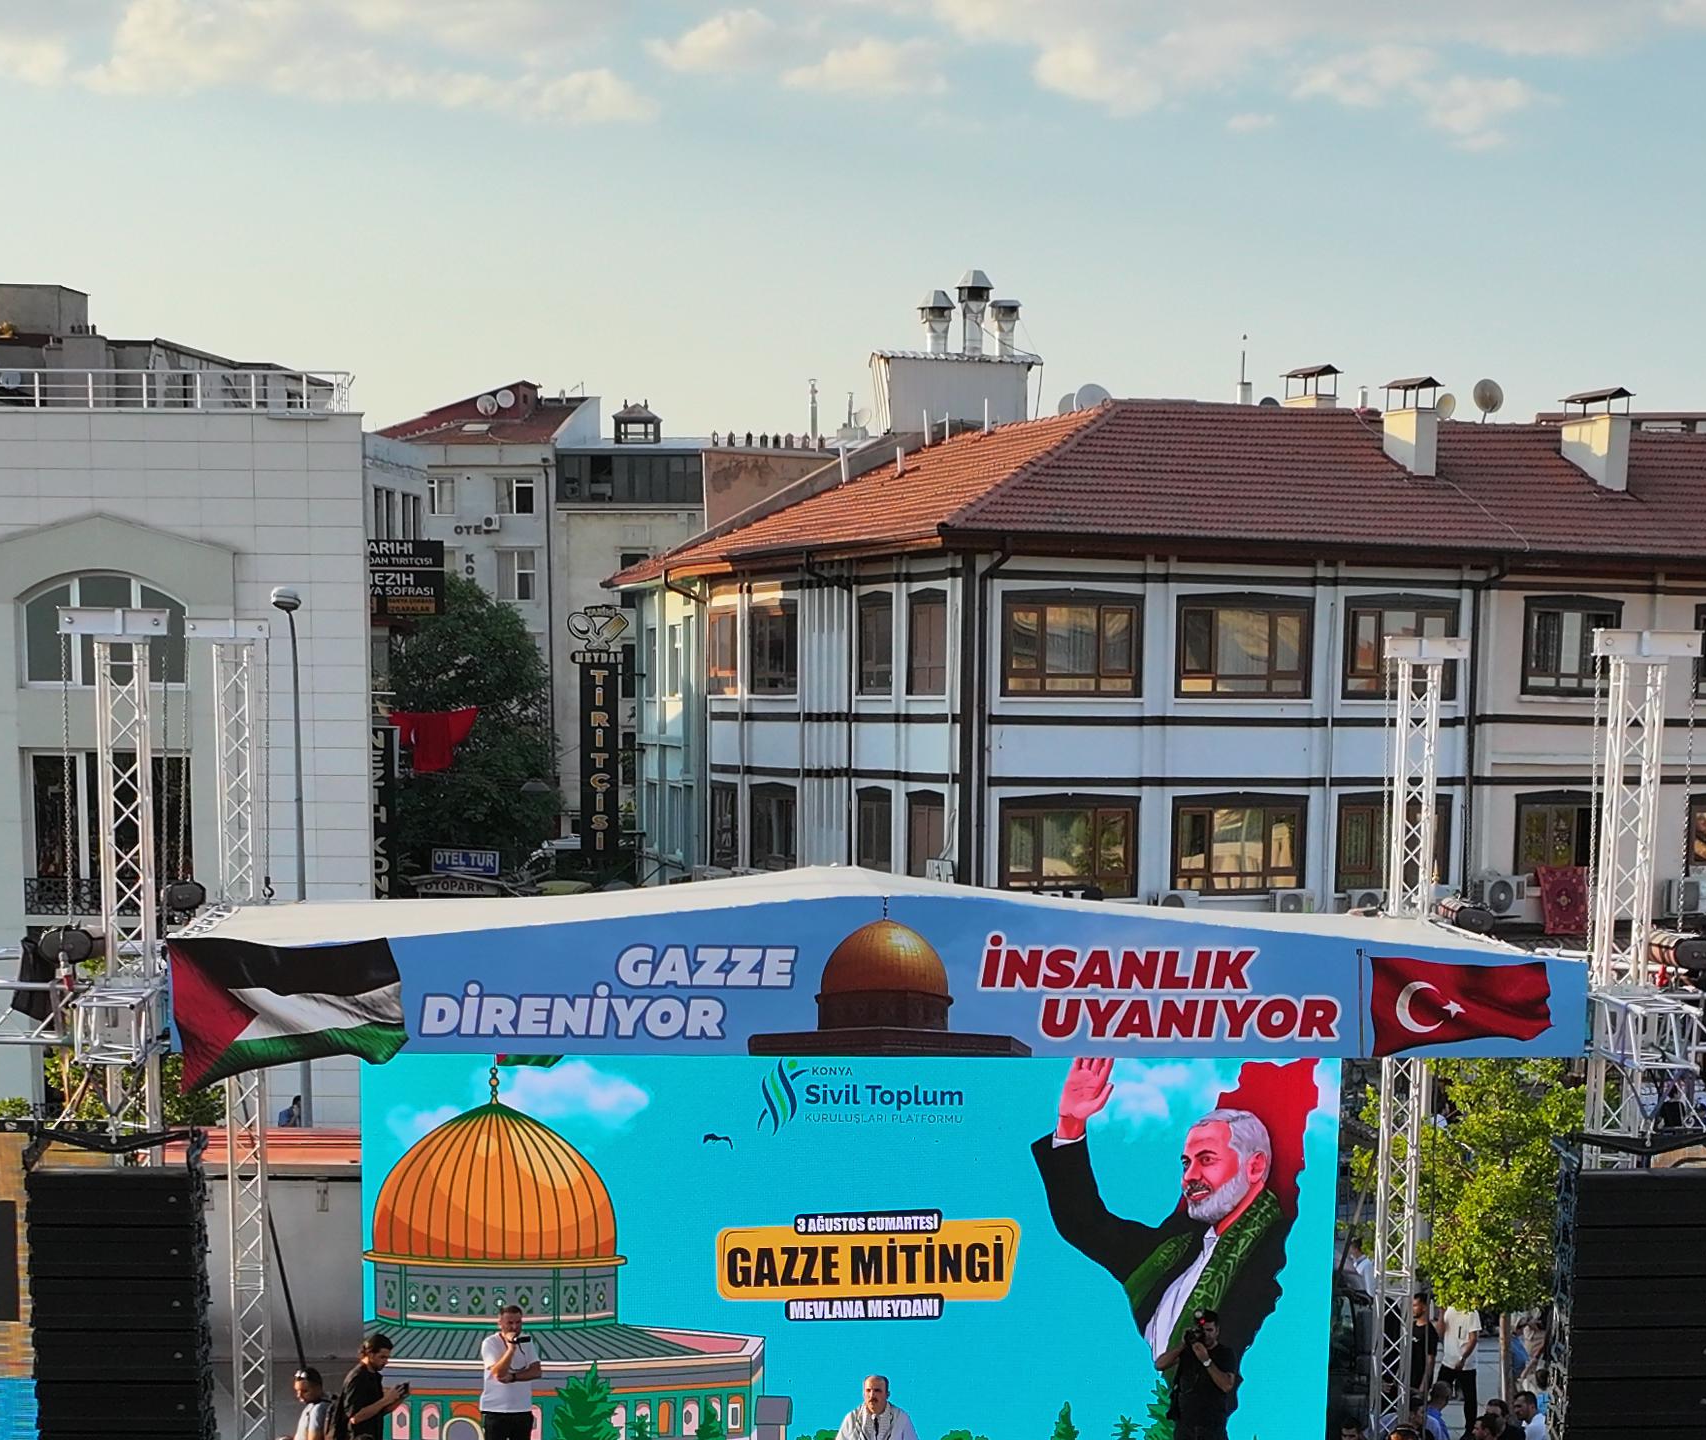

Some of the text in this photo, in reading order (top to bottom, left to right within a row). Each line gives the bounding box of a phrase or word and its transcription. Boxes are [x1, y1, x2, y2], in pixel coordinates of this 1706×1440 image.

[454, 525, 492, 535] OTE
[575, 652, 624, 664] MEYDAN
[590, 669, 611, 850] TİRİTÇİSİ
[435, 852, 494, 867] OTEL TUR
[618, 947, 796, 986] GAZZE
[980, 935, 1255, 990] İNSANLIK
[422, 985, 723, 1037] DİRENİYOR
[1042, 998, 1338, 1038] UYANIYOR
[811, 1066, 853, 1076] KONYA
[805, 1084, 963, 1111] Sivil Toplum
[804, 1113, 963, 1124] KURULUŞLARI PLATFORMU
[797, 1213, 938, 1233] 3 AĞUSTOS CUMARTESİ
[727, 1235, 1004, 1288] GAZZE MİTİNGİ
[790, 1298, 939, 1319] MEVLANA MEYDANI
